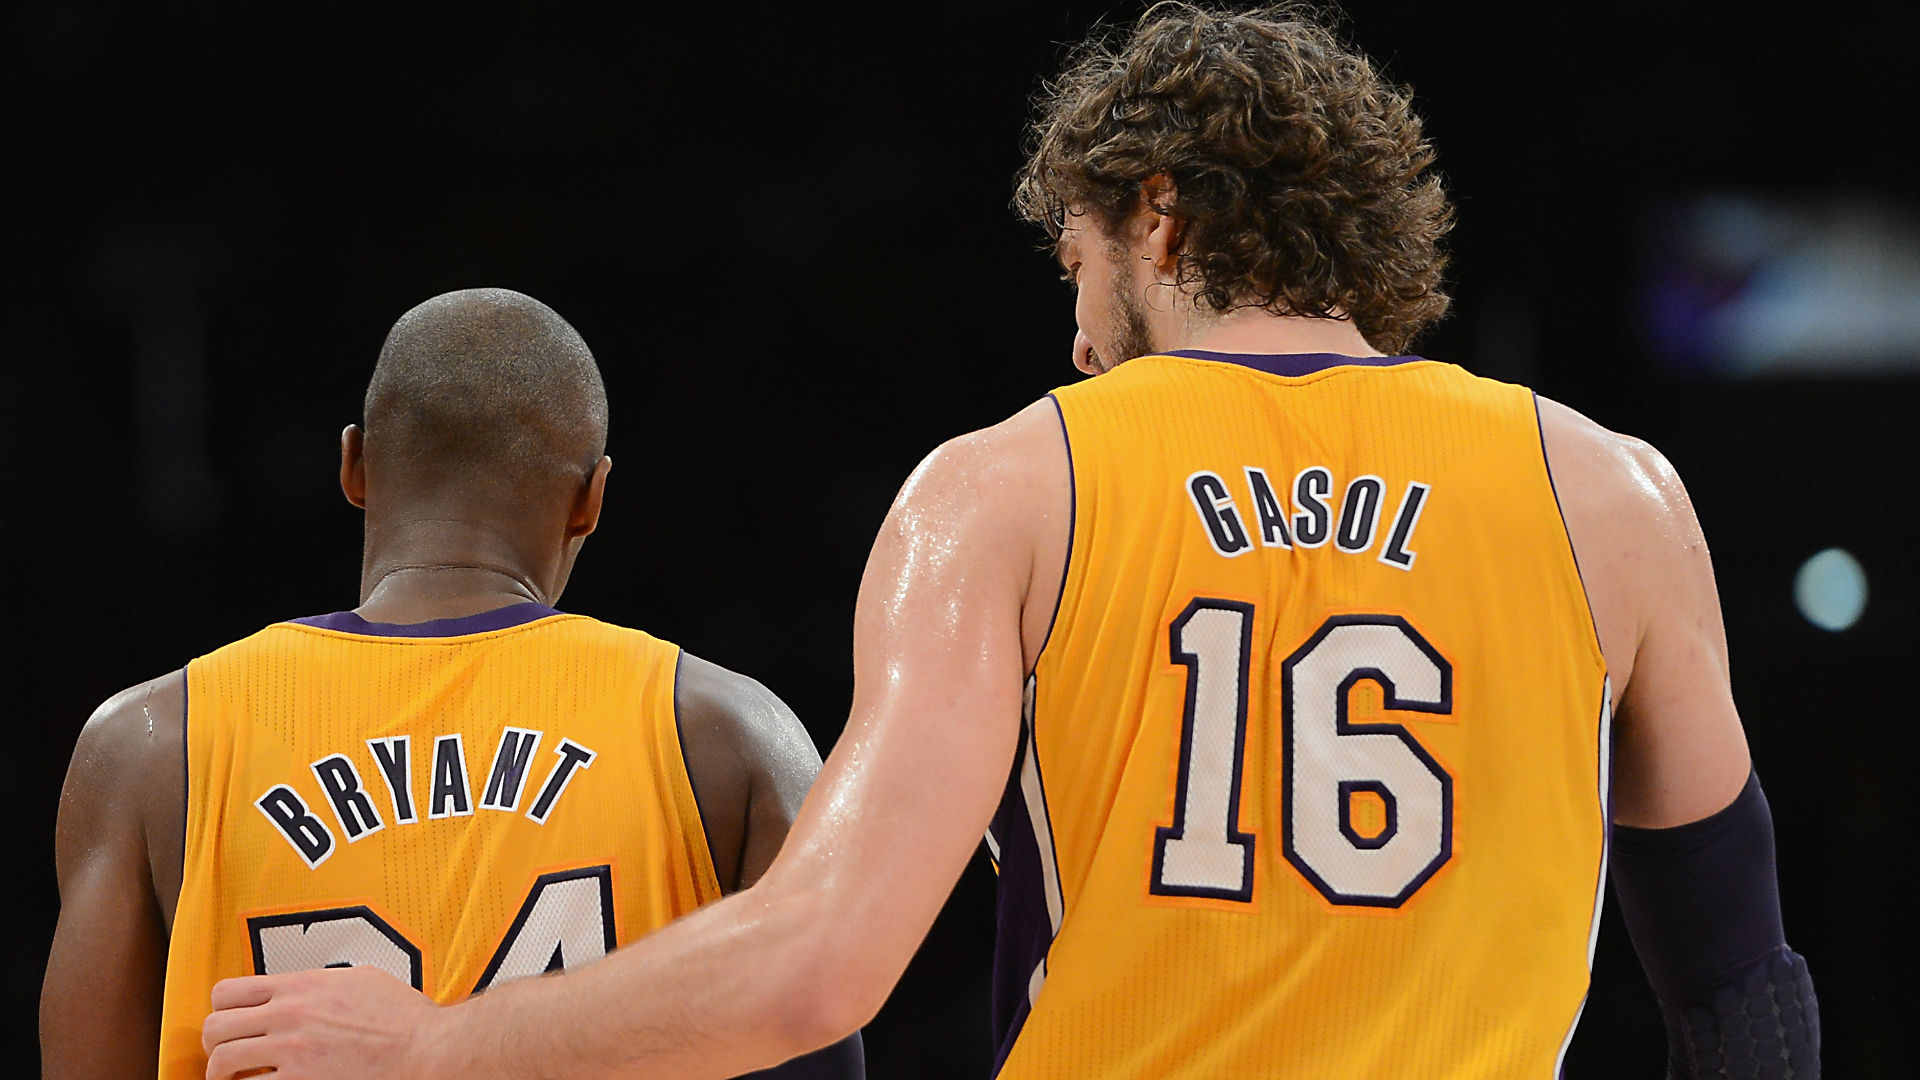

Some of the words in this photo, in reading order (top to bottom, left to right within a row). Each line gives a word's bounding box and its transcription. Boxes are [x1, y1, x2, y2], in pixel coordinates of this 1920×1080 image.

[1186, 466, 1431, 570] GASOL
[254, 726, 598, 870] BRYANT
[1149, 596, 1453, 909] 16
